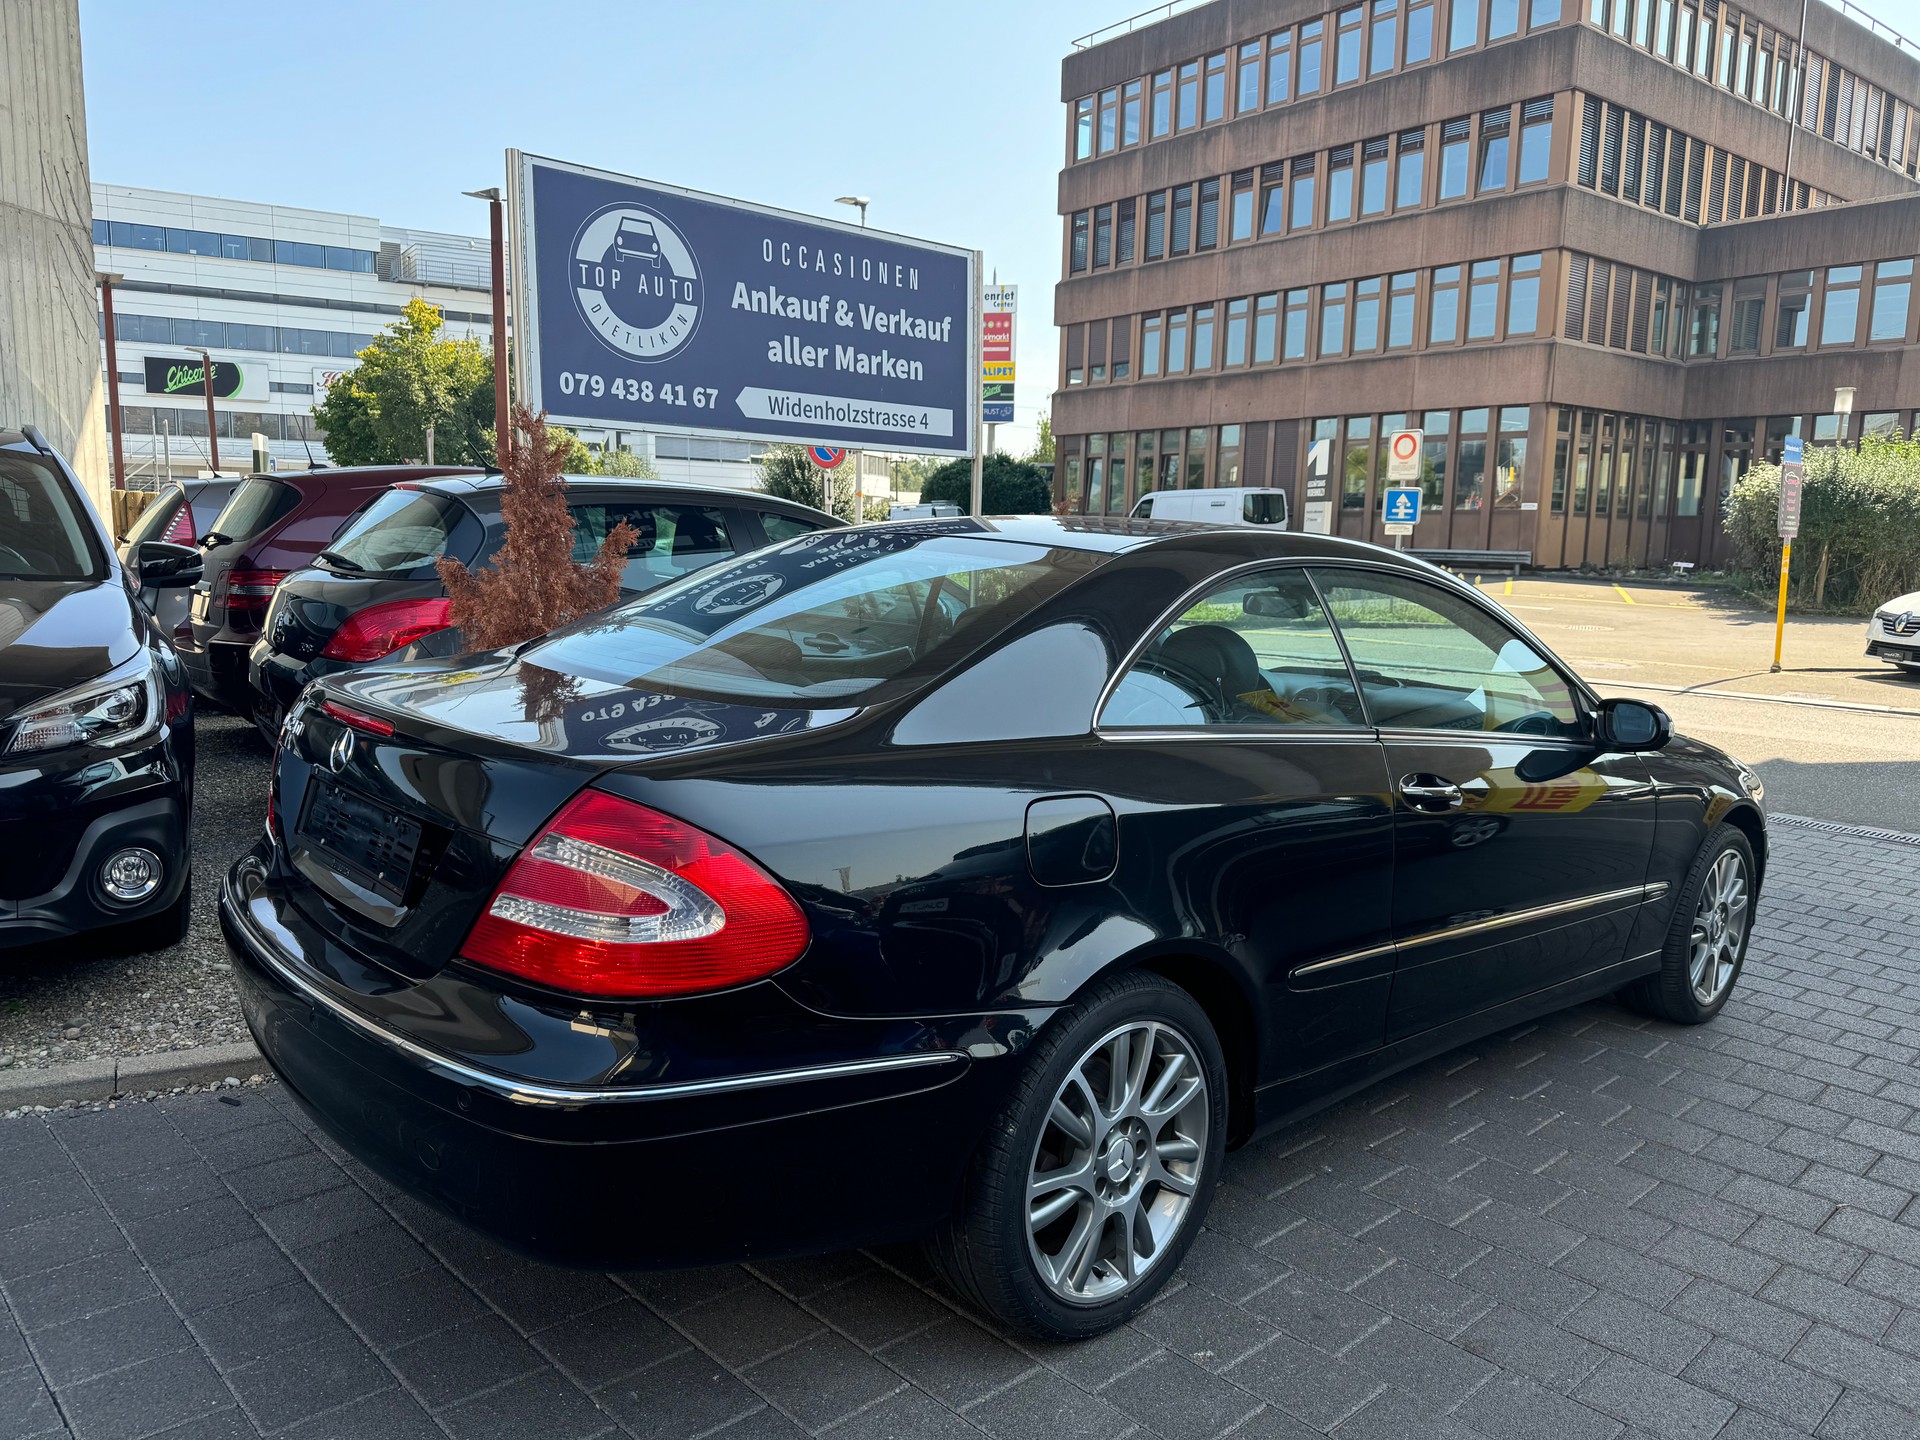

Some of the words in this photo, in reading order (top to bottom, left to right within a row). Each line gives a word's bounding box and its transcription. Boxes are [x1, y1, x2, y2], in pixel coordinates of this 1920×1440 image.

[579, 263, 621, 290] TOP
[638, 273, 693, 302] AUTO
[762, 238, 919, 291] OCCASIONEN
[590, 303, 688, 349] DIETLIKON
[731, 281, 830, 324] Ankauf
[834, 299, 854, 328] &
[858, 302, 952, 345] Verkauf
[767, 334, 829, 369] aller
[835, 344, 924, 382] Marken
[983, 367, 1014, 376] ALIPET
[559, 371, 605, 398] 079
[610, 377, 655, 403] 438
[659, 383, 687, 407] 41
[692, 386, 719, 409] 67
[767, 395, 917, 429] Widenholzstrasse
[919, 412, 929, 430] 4
[983, 407, 1000, 415] RUST
